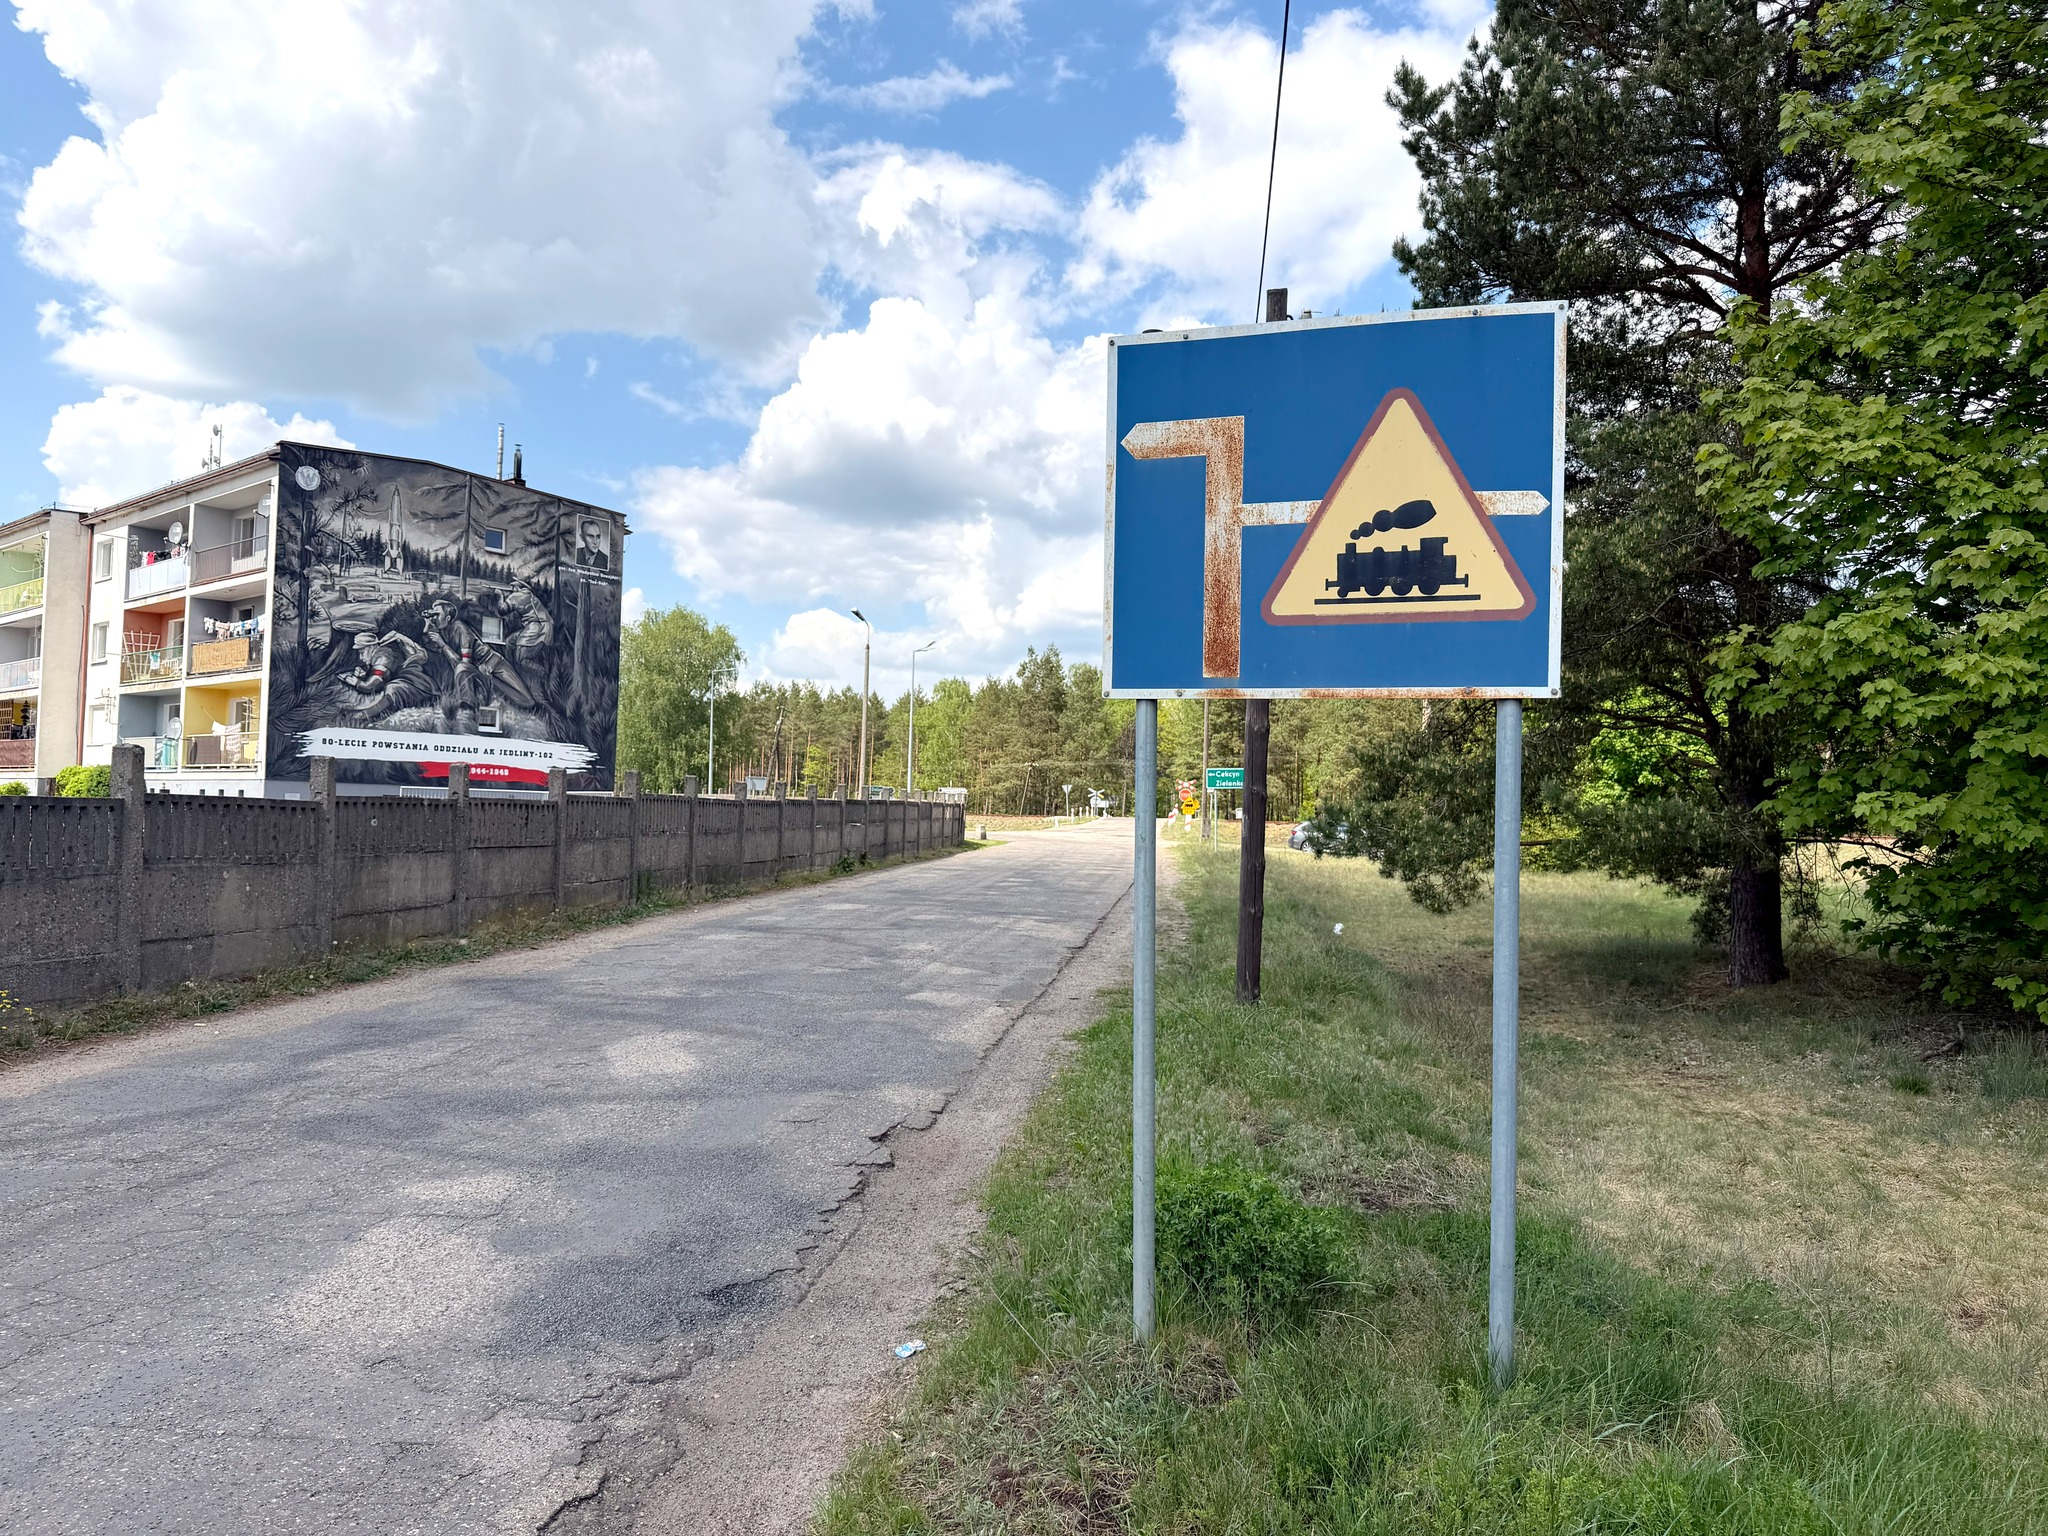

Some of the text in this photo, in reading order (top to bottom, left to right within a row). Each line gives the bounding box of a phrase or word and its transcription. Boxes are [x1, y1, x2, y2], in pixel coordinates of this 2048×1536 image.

[322, 738, 367, 748] 80-LECIE
[372, 741, 429, 751] POWSTANIA
[433, 745, 479, 754] ODDZIAŁU
[499, 749, 553, 758] JEDLINY-102
[470, 767, 509, 776] 944-1945
